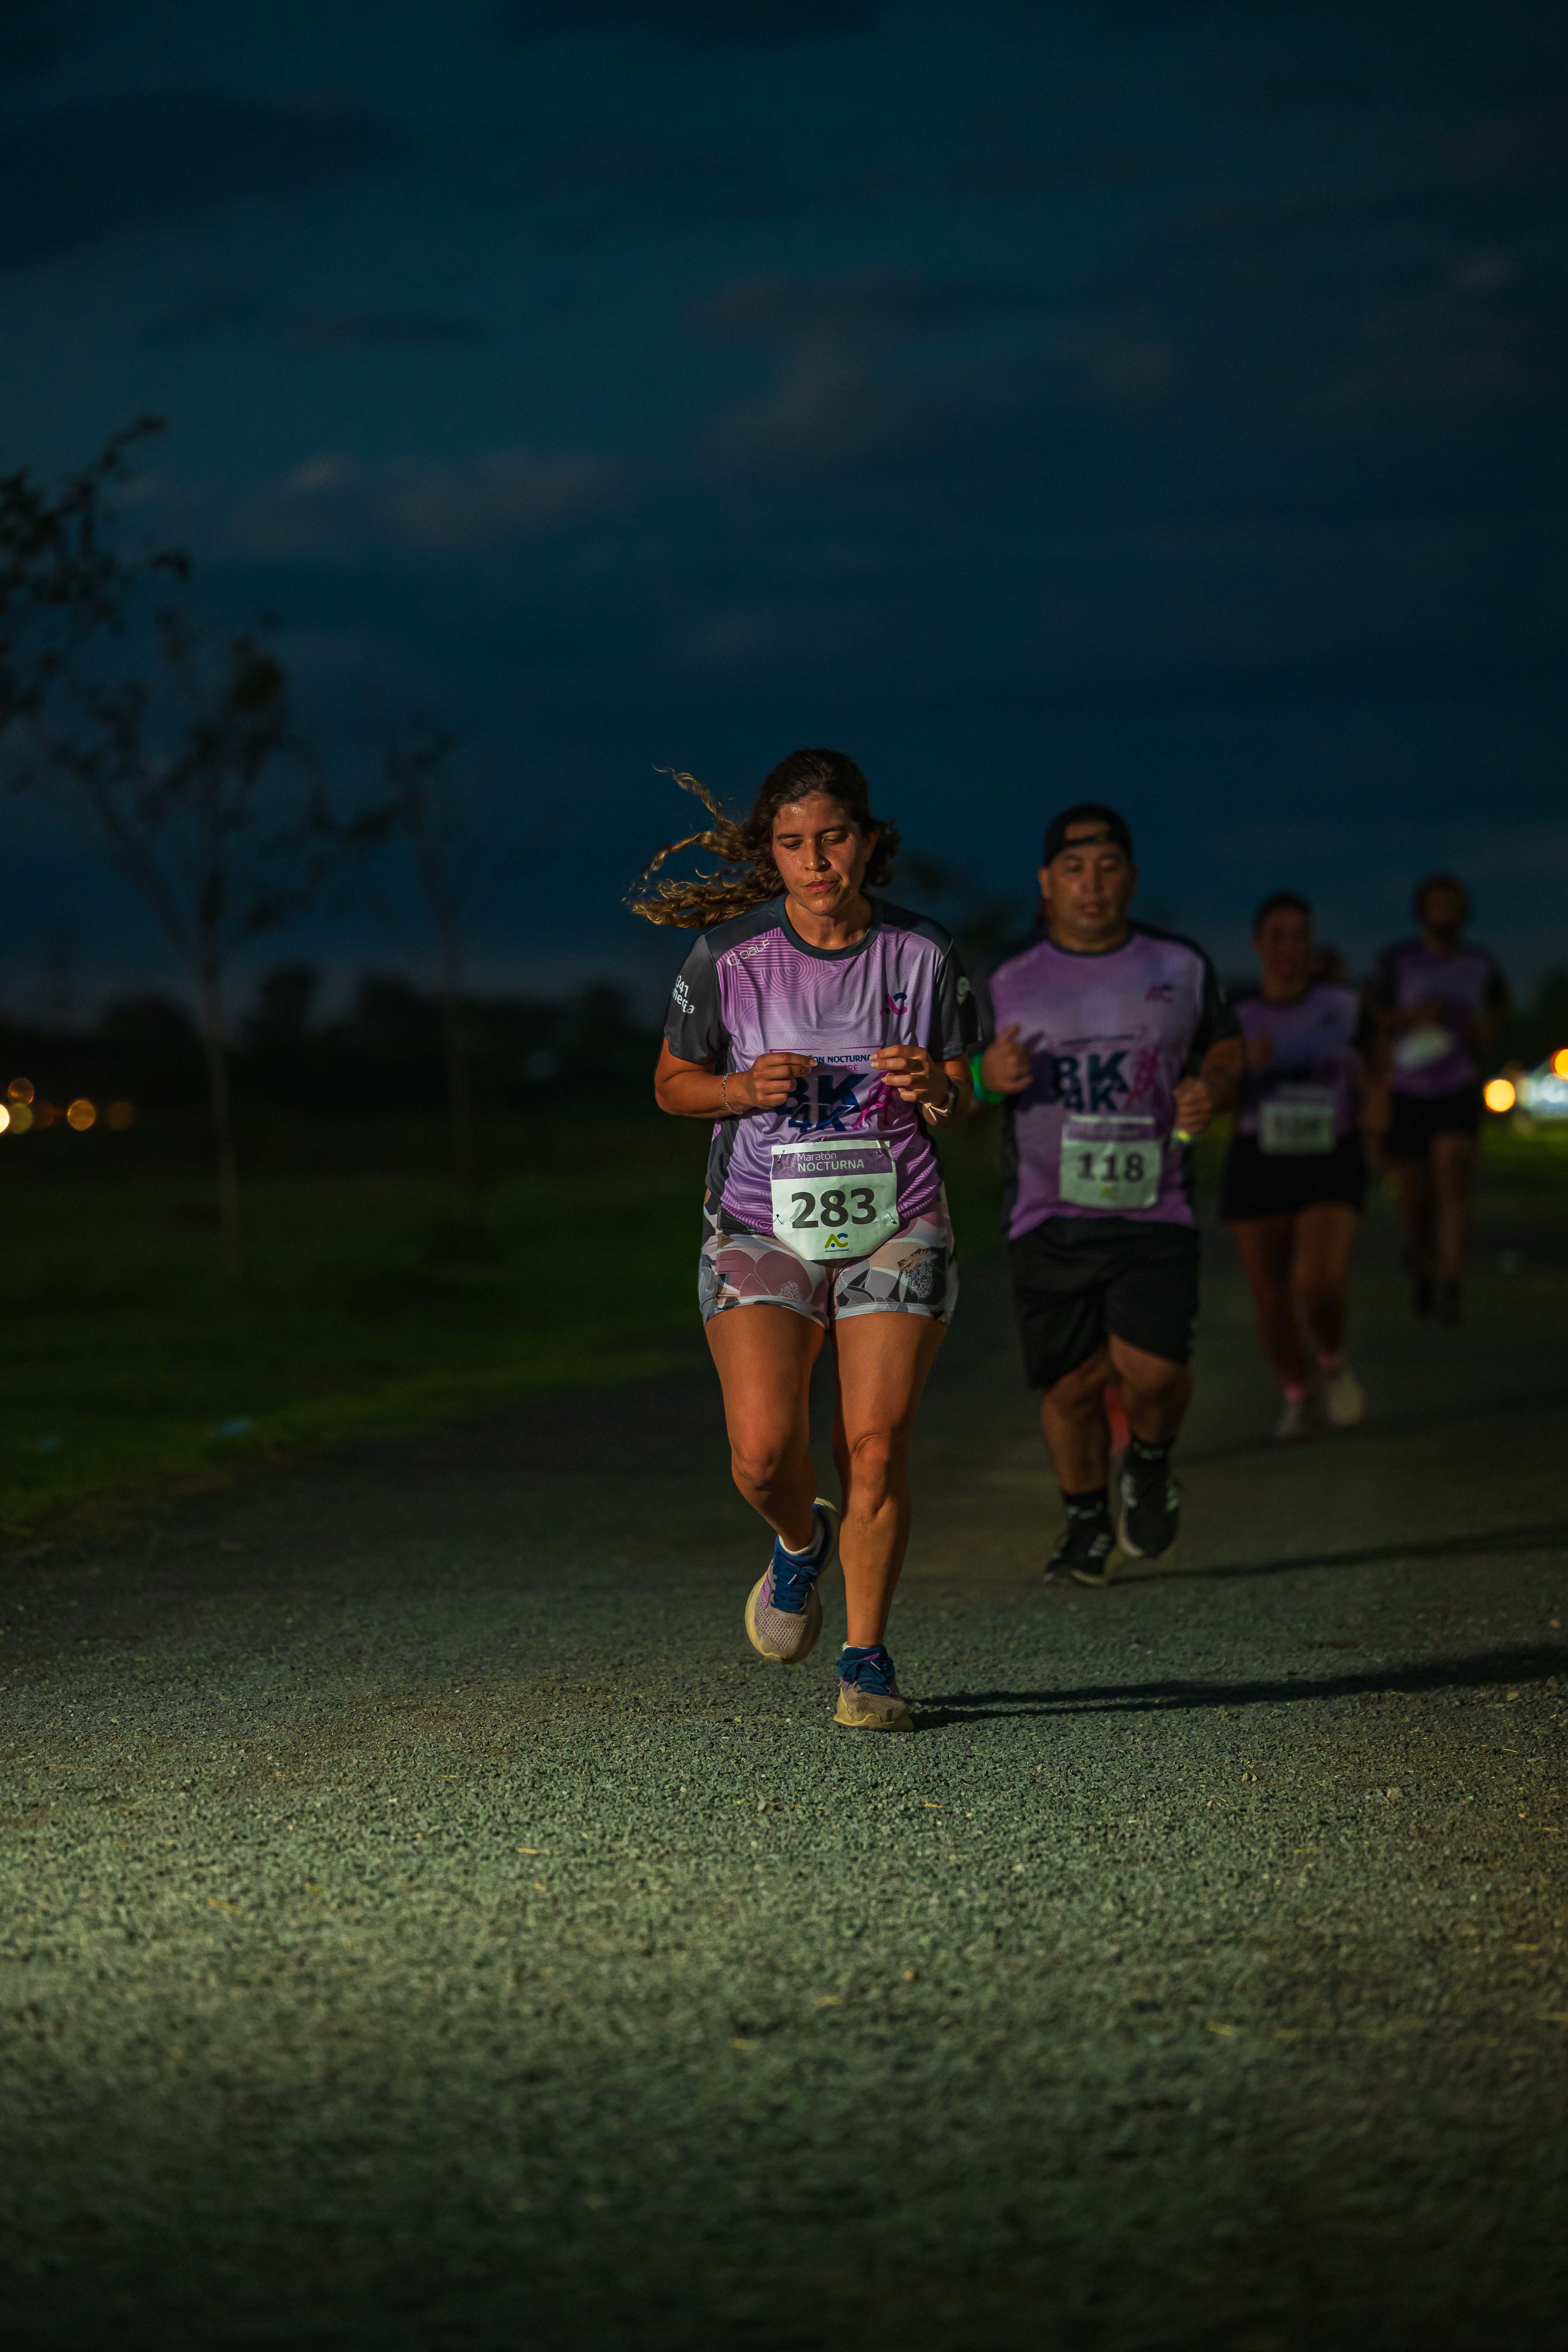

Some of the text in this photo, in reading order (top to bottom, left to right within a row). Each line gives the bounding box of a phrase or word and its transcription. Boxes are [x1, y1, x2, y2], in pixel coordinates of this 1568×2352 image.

[675, 975, 689, 998] 341
[797, 1151, 836, 1161] Maratón
[797, 1159, 865, 1172] NOCTURNA
[1078, 1153, 1143, 1182] 118
[792, 1188, 876, 1228] 283
